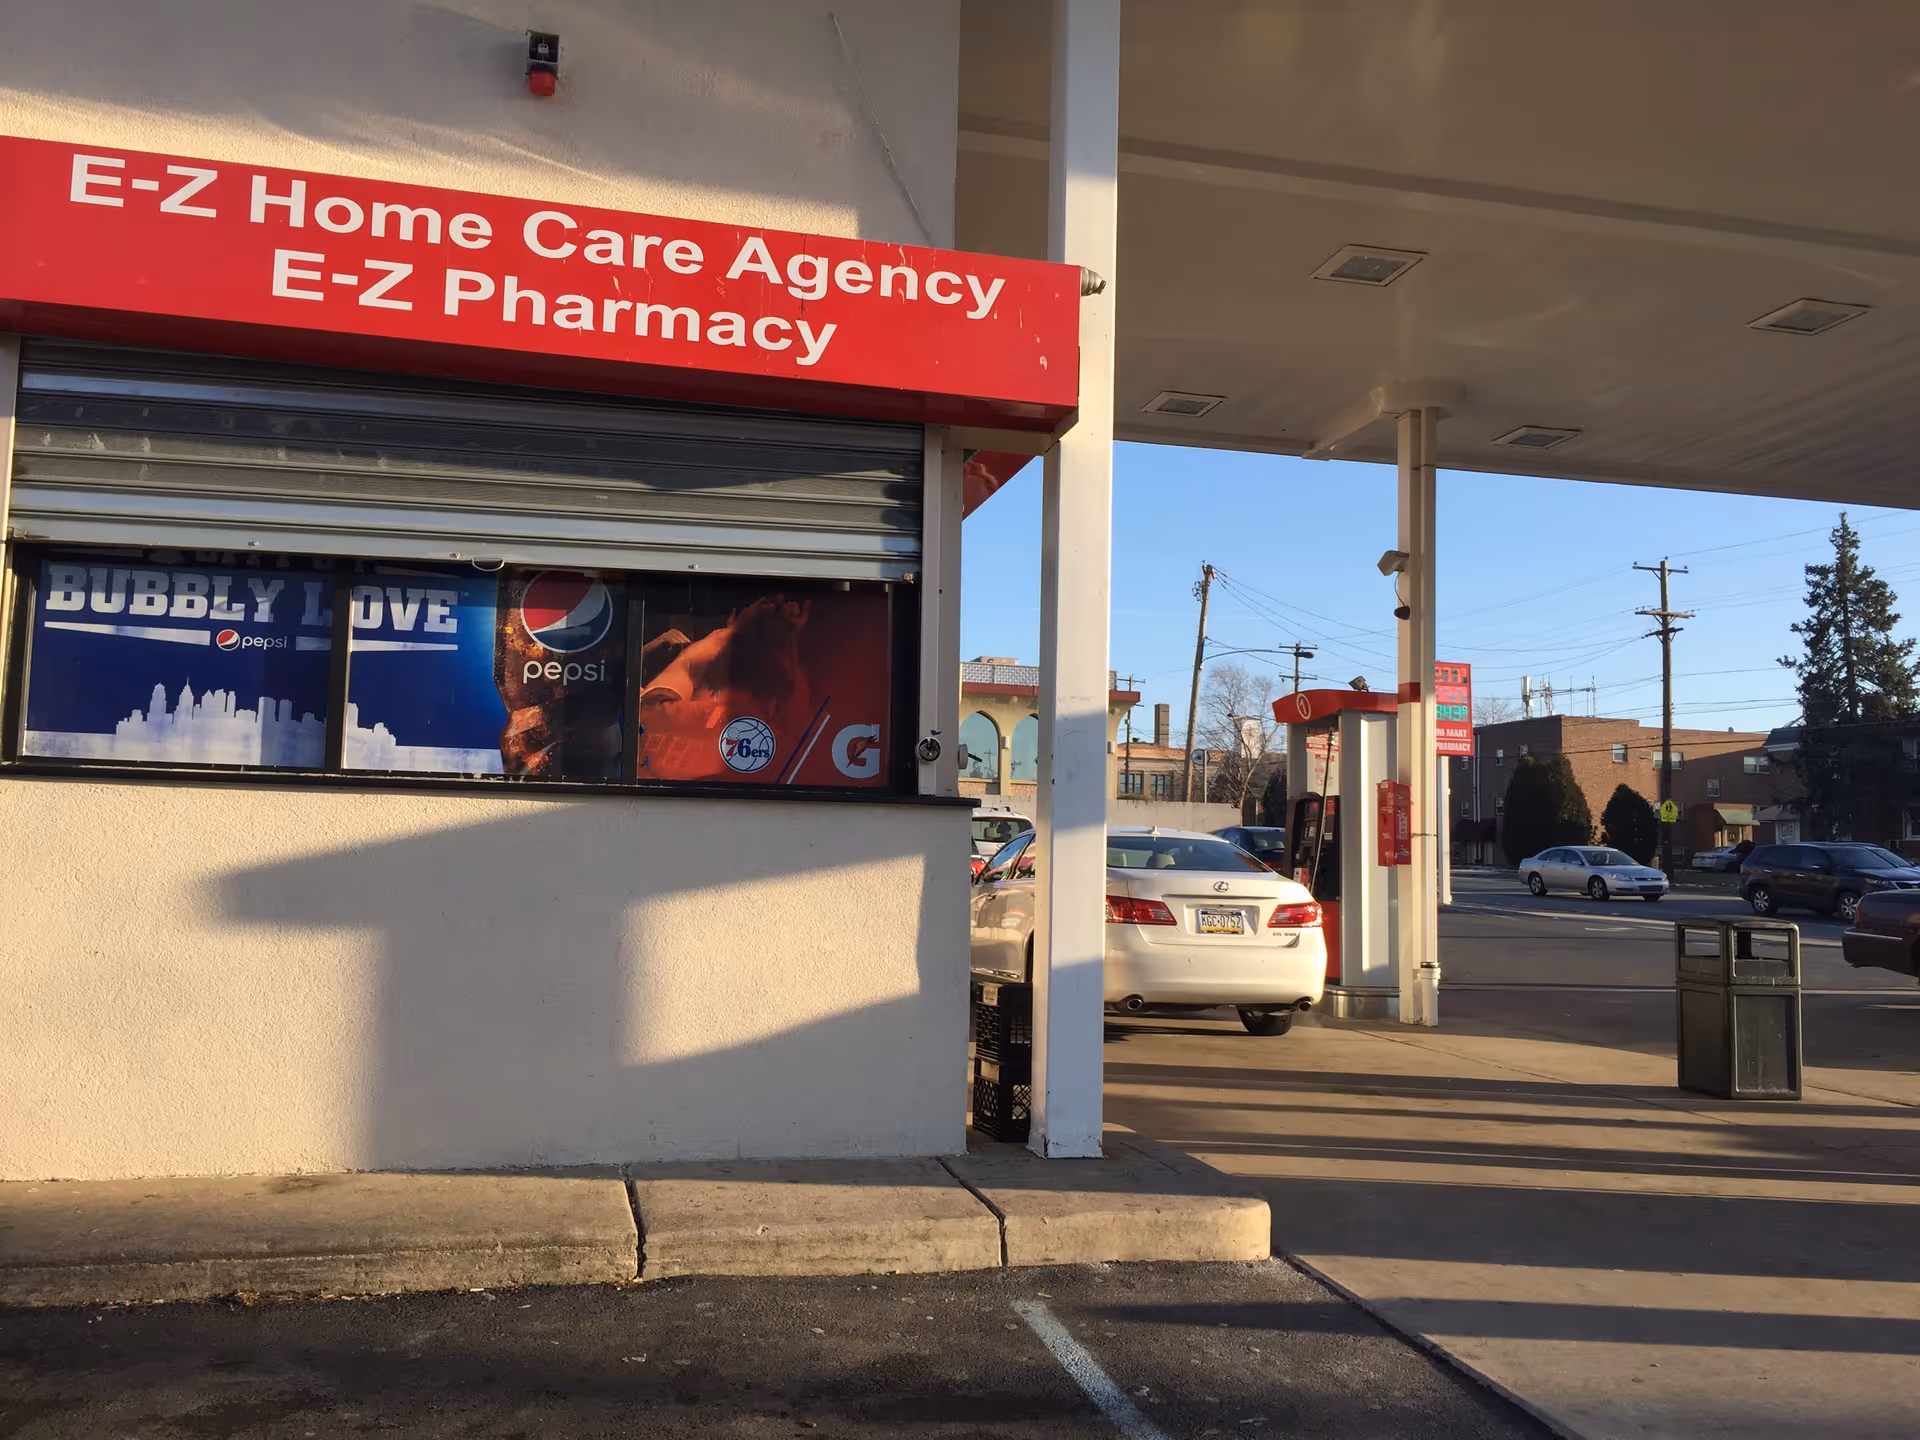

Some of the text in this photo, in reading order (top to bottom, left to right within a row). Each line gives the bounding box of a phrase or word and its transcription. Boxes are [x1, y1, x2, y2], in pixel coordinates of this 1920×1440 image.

[70, 153, 1006, 320] E-Z Home Care Agency
[271, 248, 838, 366] E-Z Pharmacy
[46, 565, 458, 634] BUBBLY LOVE
[241, 635, 288, 650] pepsi
[522, 659, 606, 685] pepsi
[725, 737, 771, 759] 76ers
[831, 723, 881, 779] G
[1446, 729, 1468, 738] MART
